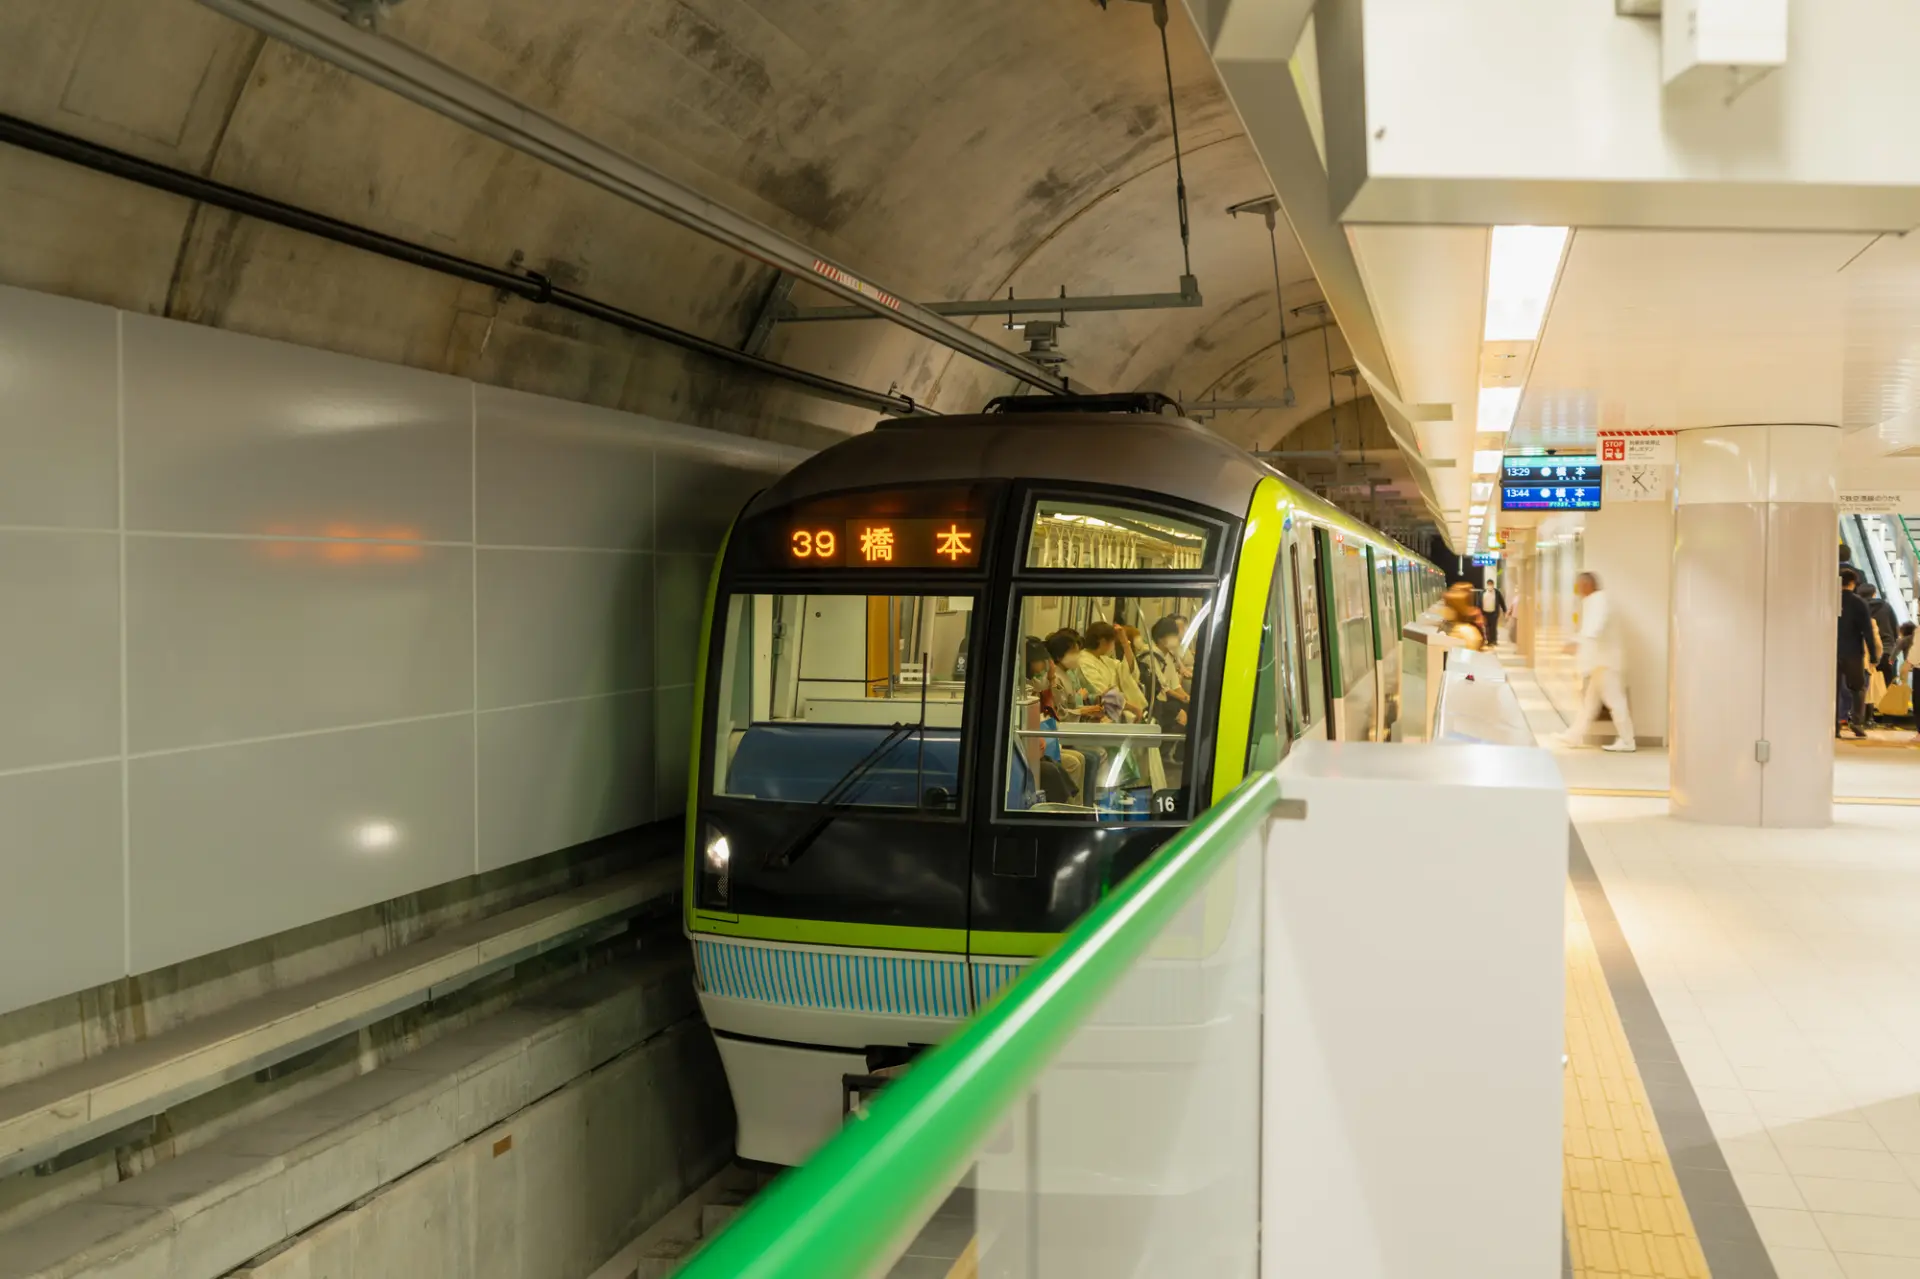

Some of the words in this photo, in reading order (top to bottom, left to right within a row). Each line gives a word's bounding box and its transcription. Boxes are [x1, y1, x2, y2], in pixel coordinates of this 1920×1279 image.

[1506, 467, 1531, 476] 13:29
[1506, 489, 1530, 498] 13:44
[792, 530, 835, 558] 39
[1156, 796, 1175, 813] 16
